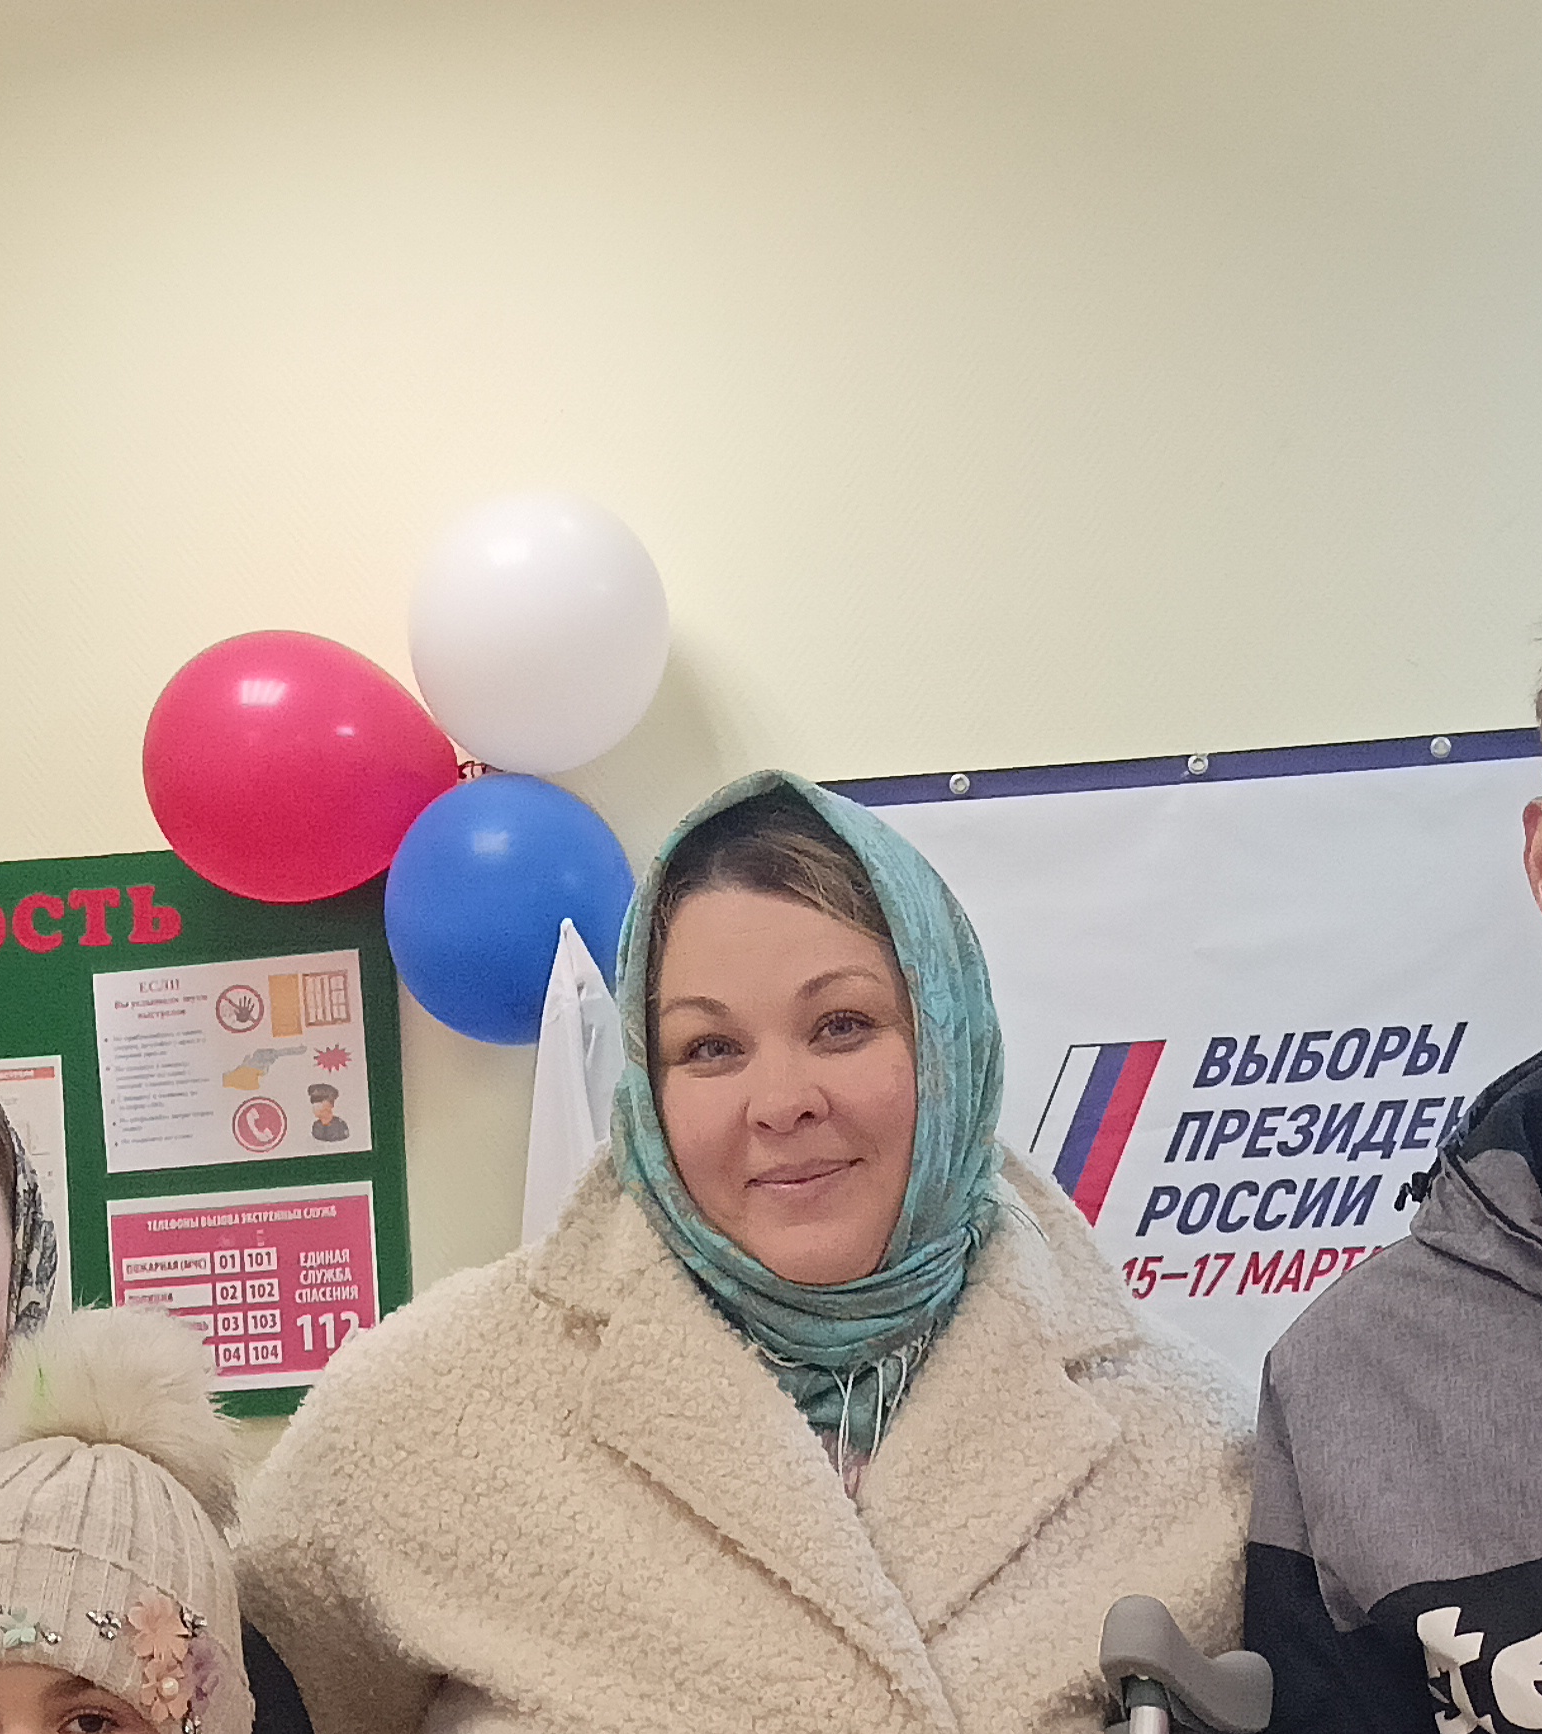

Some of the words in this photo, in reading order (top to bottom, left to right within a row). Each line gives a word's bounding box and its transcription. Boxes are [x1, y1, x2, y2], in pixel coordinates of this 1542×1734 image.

[1193, 1021, 1469, 1089] ВЫБОРЫ
[1136, 1174, 1383, 1237] РОССИИ
[219, 1254, 236, 1270] 01
[247, 1252, 273, 1267] 101
[299, 1248, 351, 1267] ЕДИНАЯ
[299, 1267, 353, 1286] СЛУЖБА
[1235, 1245, 1384, 1296] МАРТ
[219, 1285, 238, 1301] 02
[249, 1282, 275, 1299] 102
[295, 1285, 359, 1304] СПАСЕНИЯ
[221, 1316, 240, 1332] 03
[251, 1313, 278, 1329] 103
[223, 1347, 241, 1362] 04
[252, 1344, 279, 1360] 104
